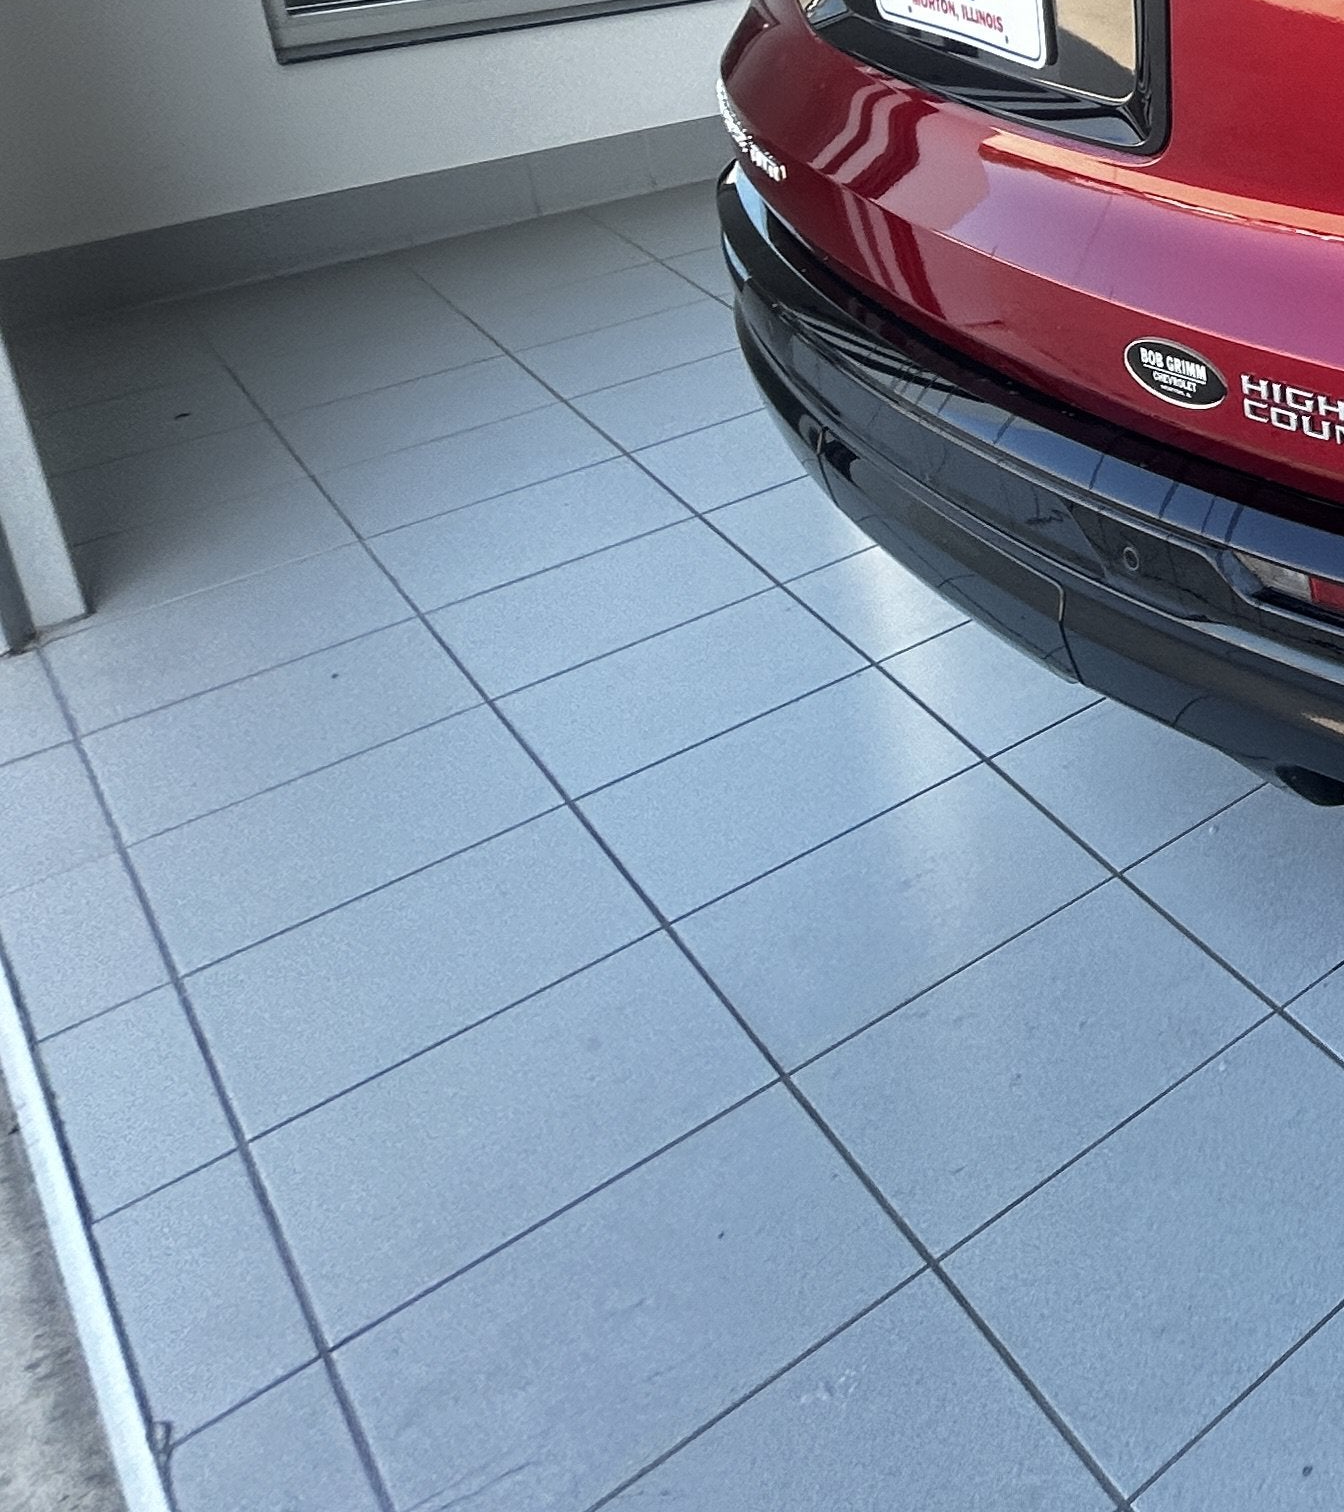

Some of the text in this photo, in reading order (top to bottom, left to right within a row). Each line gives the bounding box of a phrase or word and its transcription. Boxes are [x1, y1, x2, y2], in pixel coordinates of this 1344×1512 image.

[961, 4, 1004, 34] ILLINOIS
[1140, 346, 1207, 382] BOB GRIMM
